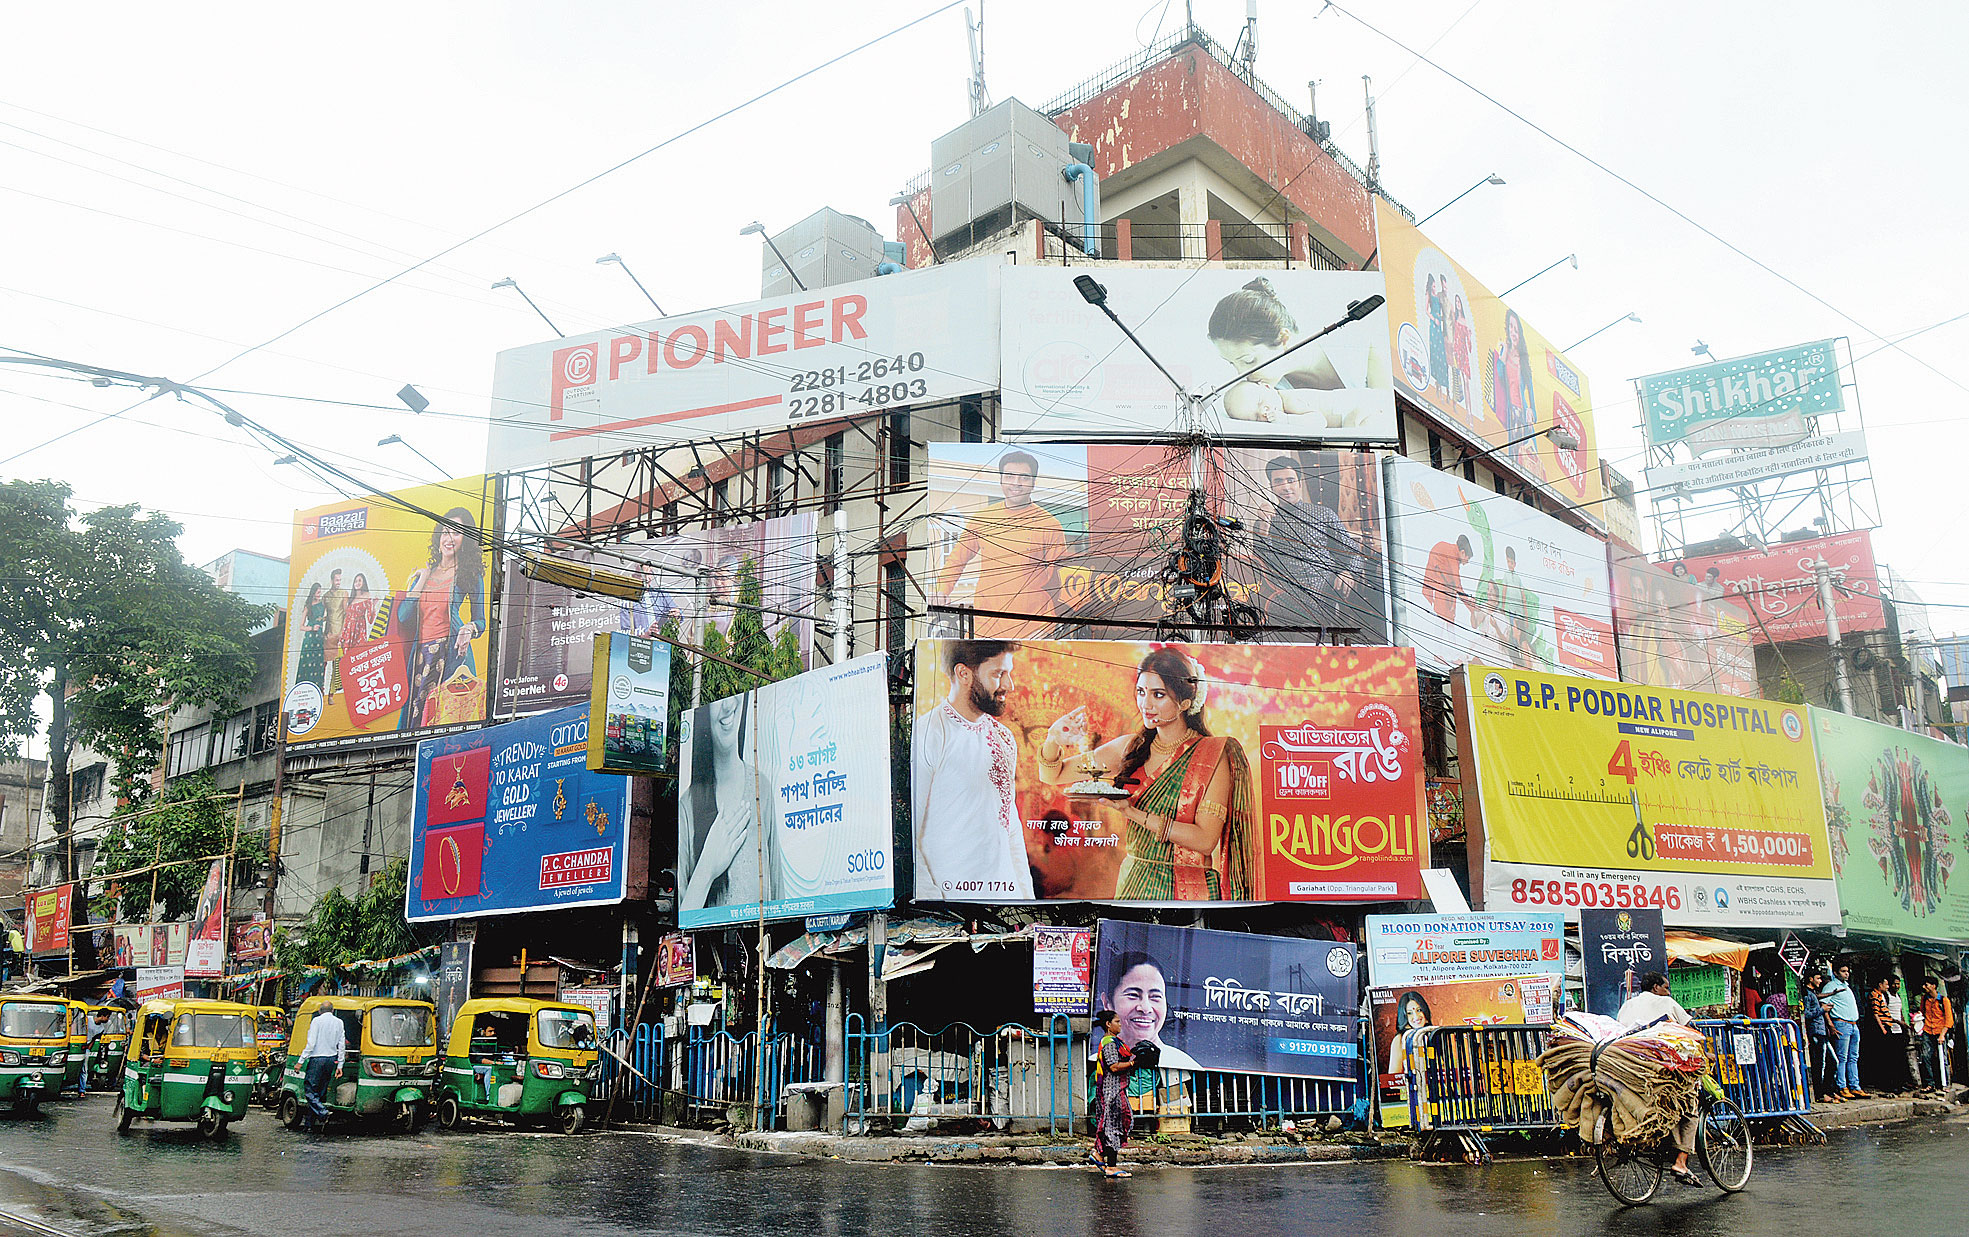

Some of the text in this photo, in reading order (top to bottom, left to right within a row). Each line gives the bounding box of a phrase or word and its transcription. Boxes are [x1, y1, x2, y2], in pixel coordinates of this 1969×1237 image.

[609, 294, 869, 381] PIONEER
[790, 351, 926, 393] 2281-2640
[788, 378, 928, 420] 2281-4803
[1658, 365, 1818, 421] Shikhar
[1108, 496, 1152, 513] সকাল
[320, 510, 365, 527] Baazar
[324, 520, 365, 535] Kolkata
[551, 602, 606, 617] #LiveMore
[551, 613, 621, 632] West Bengal's
[550, 632, 586, 646] fastest
[357, 666, 386, 693] হল
[554, 676, 567, 687] 4G
[1515, 679, 1778, 736] B.P. PODDAR HOSPITAL
[1284, 723, 1370, 745] আভিজাত্যের
[1634, 725, 1678, 738] NEW ALIPORE
[500, 741, 540, 767] TRENDY
[547, 754, 587, 770] STARTING FROM
[508, 763, 541, 783] KARAT
[1607, 739, 1638, 785] 4
[1677, 755, 1712, 781] কেটে
[1715, 758, 1742, 785] হার্ট
[1745, 761, 1799, 790] বাইপাস
[1536, 773, 1605, 787] 1 2 3
[502, 784, 530, 806] GOLD
[780, 779, 809, 803] শপথ
[493, 803, 538, 824] JEWELLERY
[784, 803, 844, 831] অঙ্গদানের
[1269, 814, 1414, 858] RANGOLI
[1660, 831, 1703, 851] প্যাকেজ
[1721, 833, 1808, 858] 1,50,000/-
[564, 850, 610, 869] CHANDRA
[847, 850, 885, 875] sotto
[1359, 854, 1414, 863] rangoliindia.com
[542, 867, 609, 883] JEWELLERS
[1561, 869, 1641, 883] Call in any Emergency
[955, 880, 1015, 892] 4007 1716
[1296, 884, 1394, 894] Gariahat (Opp. Triangular Park)
[1510, 878, 1682, 911] 8585035846
[1736, 896, 1787, 906] WBHS Cashless
[1381, 920, 1554, 935] BLOOD DONATION UTSAV 2019
[1415, 939, 1434, 951] 26
[1454, 938, 1475, 946] Organised
[1411, 949, 1539, 965] ALIPORE SUVECHHA
[1432, 965, 1455, 973] Alipore
[1456, 964, 1482, 972] Avenue,
[1034, 996, 1089, 1004] BIBHUTI
[1202, 976, 1324, 1017] দিদিকে বলো
[1173, 1010, 1348, 1034] আপনার মতামত বা সমস্যা থাকলে আমাকে ফোন করুন
[1289, 1041, 1348, 1056] 91370 91370
